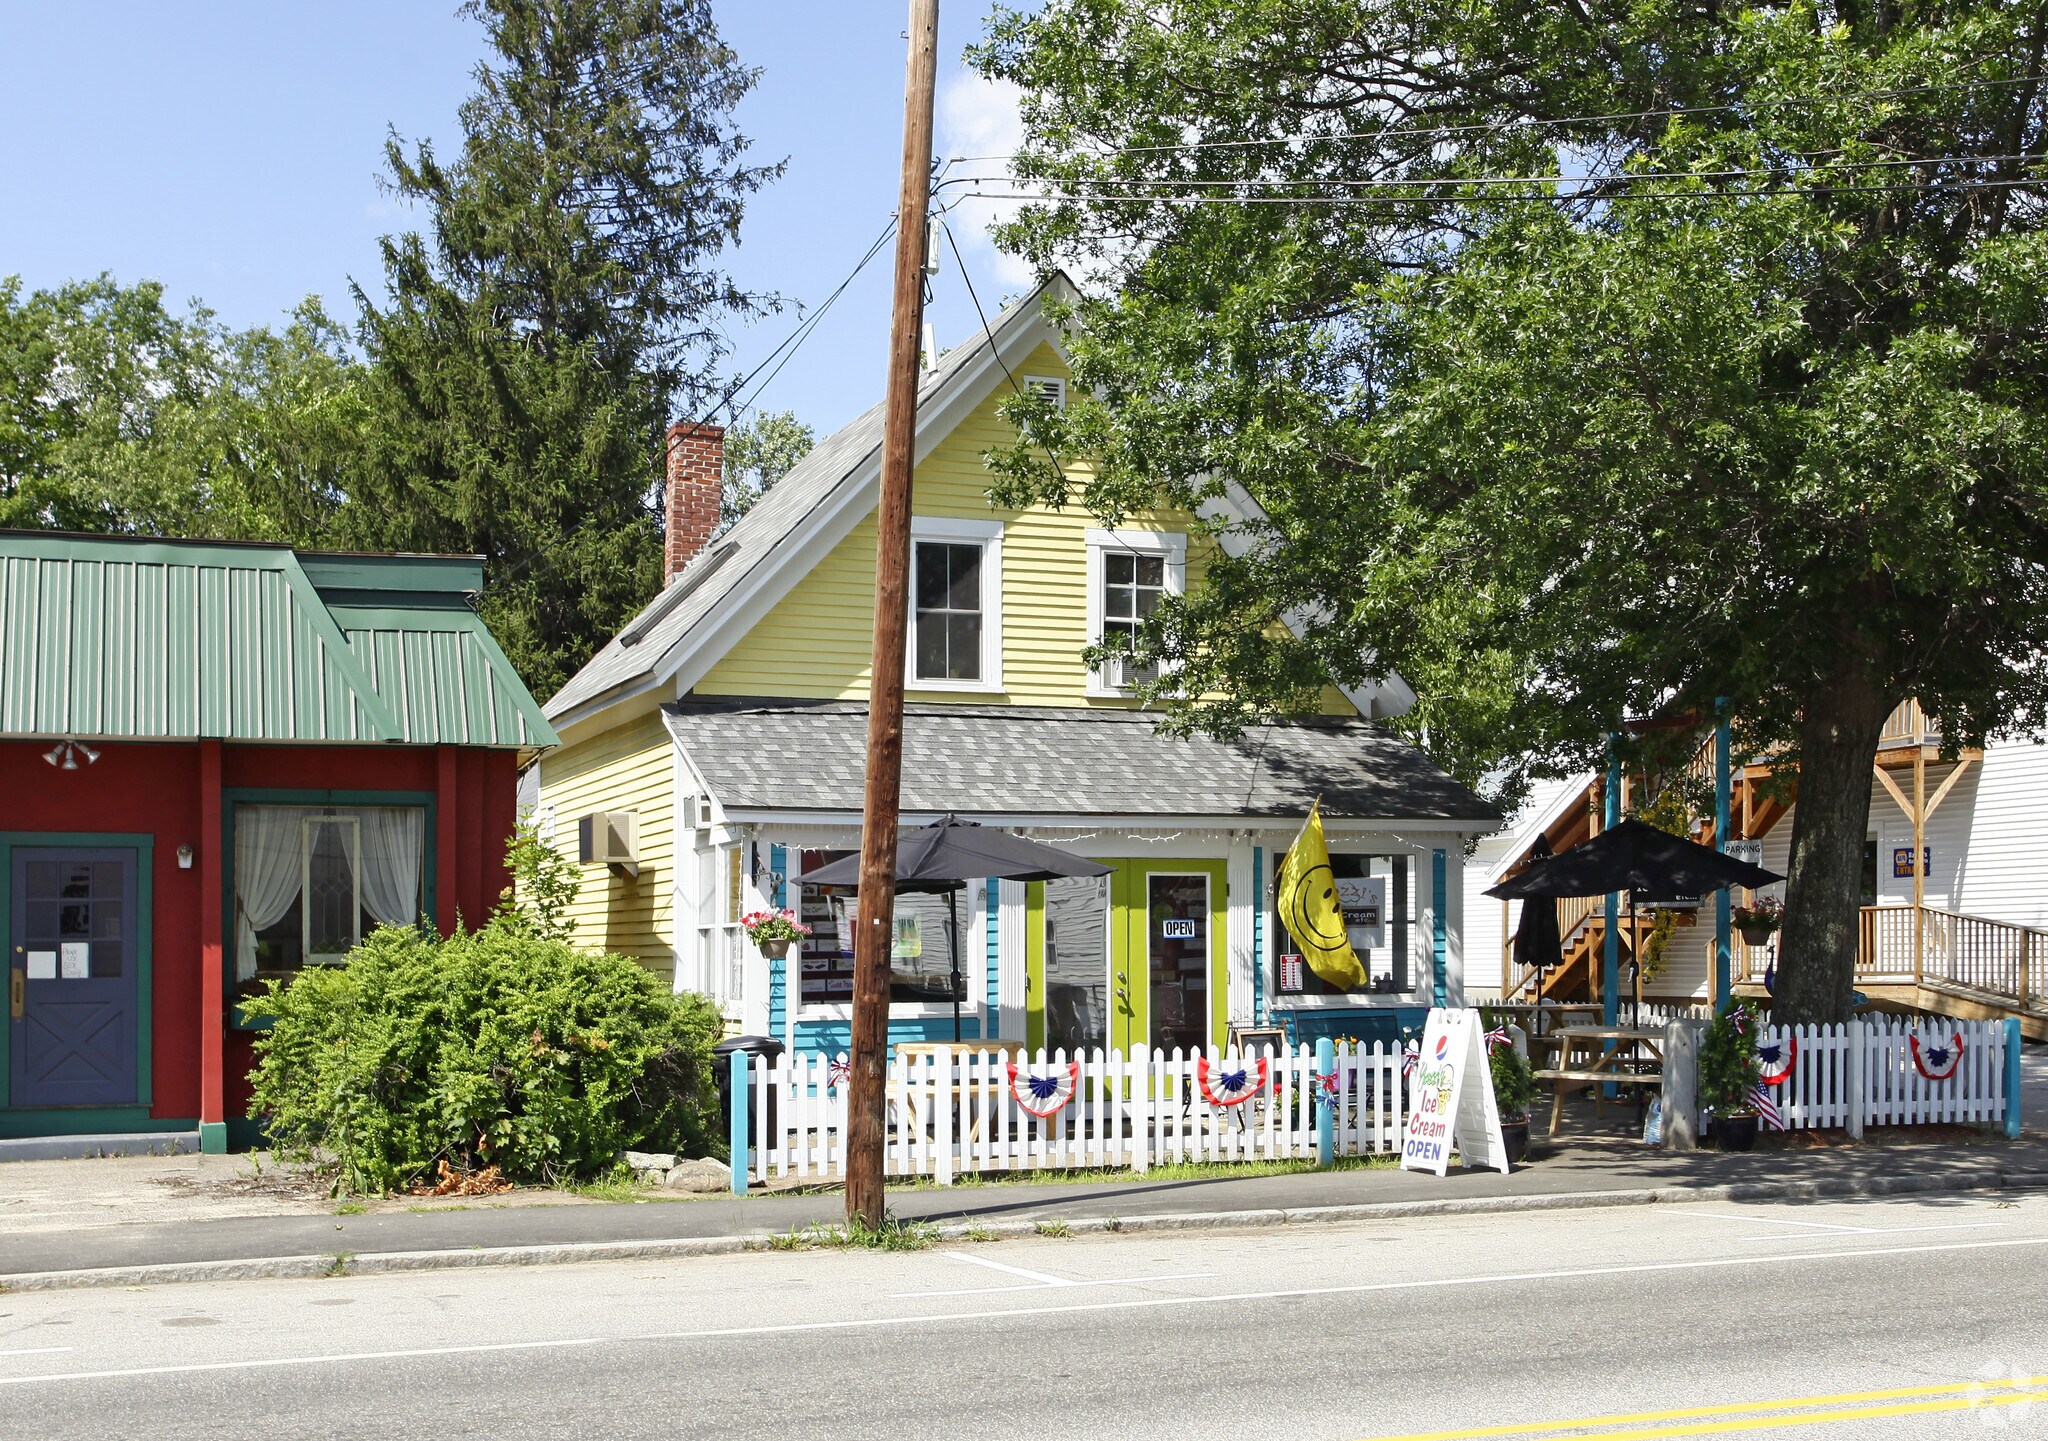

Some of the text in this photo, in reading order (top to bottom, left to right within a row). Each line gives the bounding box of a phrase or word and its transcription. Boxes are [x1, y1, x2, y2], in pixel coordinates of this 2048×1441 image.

[1725, 844, 1761, 854] PARKING
[1896, 865, 1927, 875] ENTRAE
[1340, 886, 1378, 904] zzi's
[1342, 911, 1376, 919] Cream
[1166, 921, 1193, 936] OPEN
[1420, 1089, 1437, 1114] Ice
[1410, 1113, 1446, 1138] Cream
[1406, 1139, 1441, 1161] OPEN
